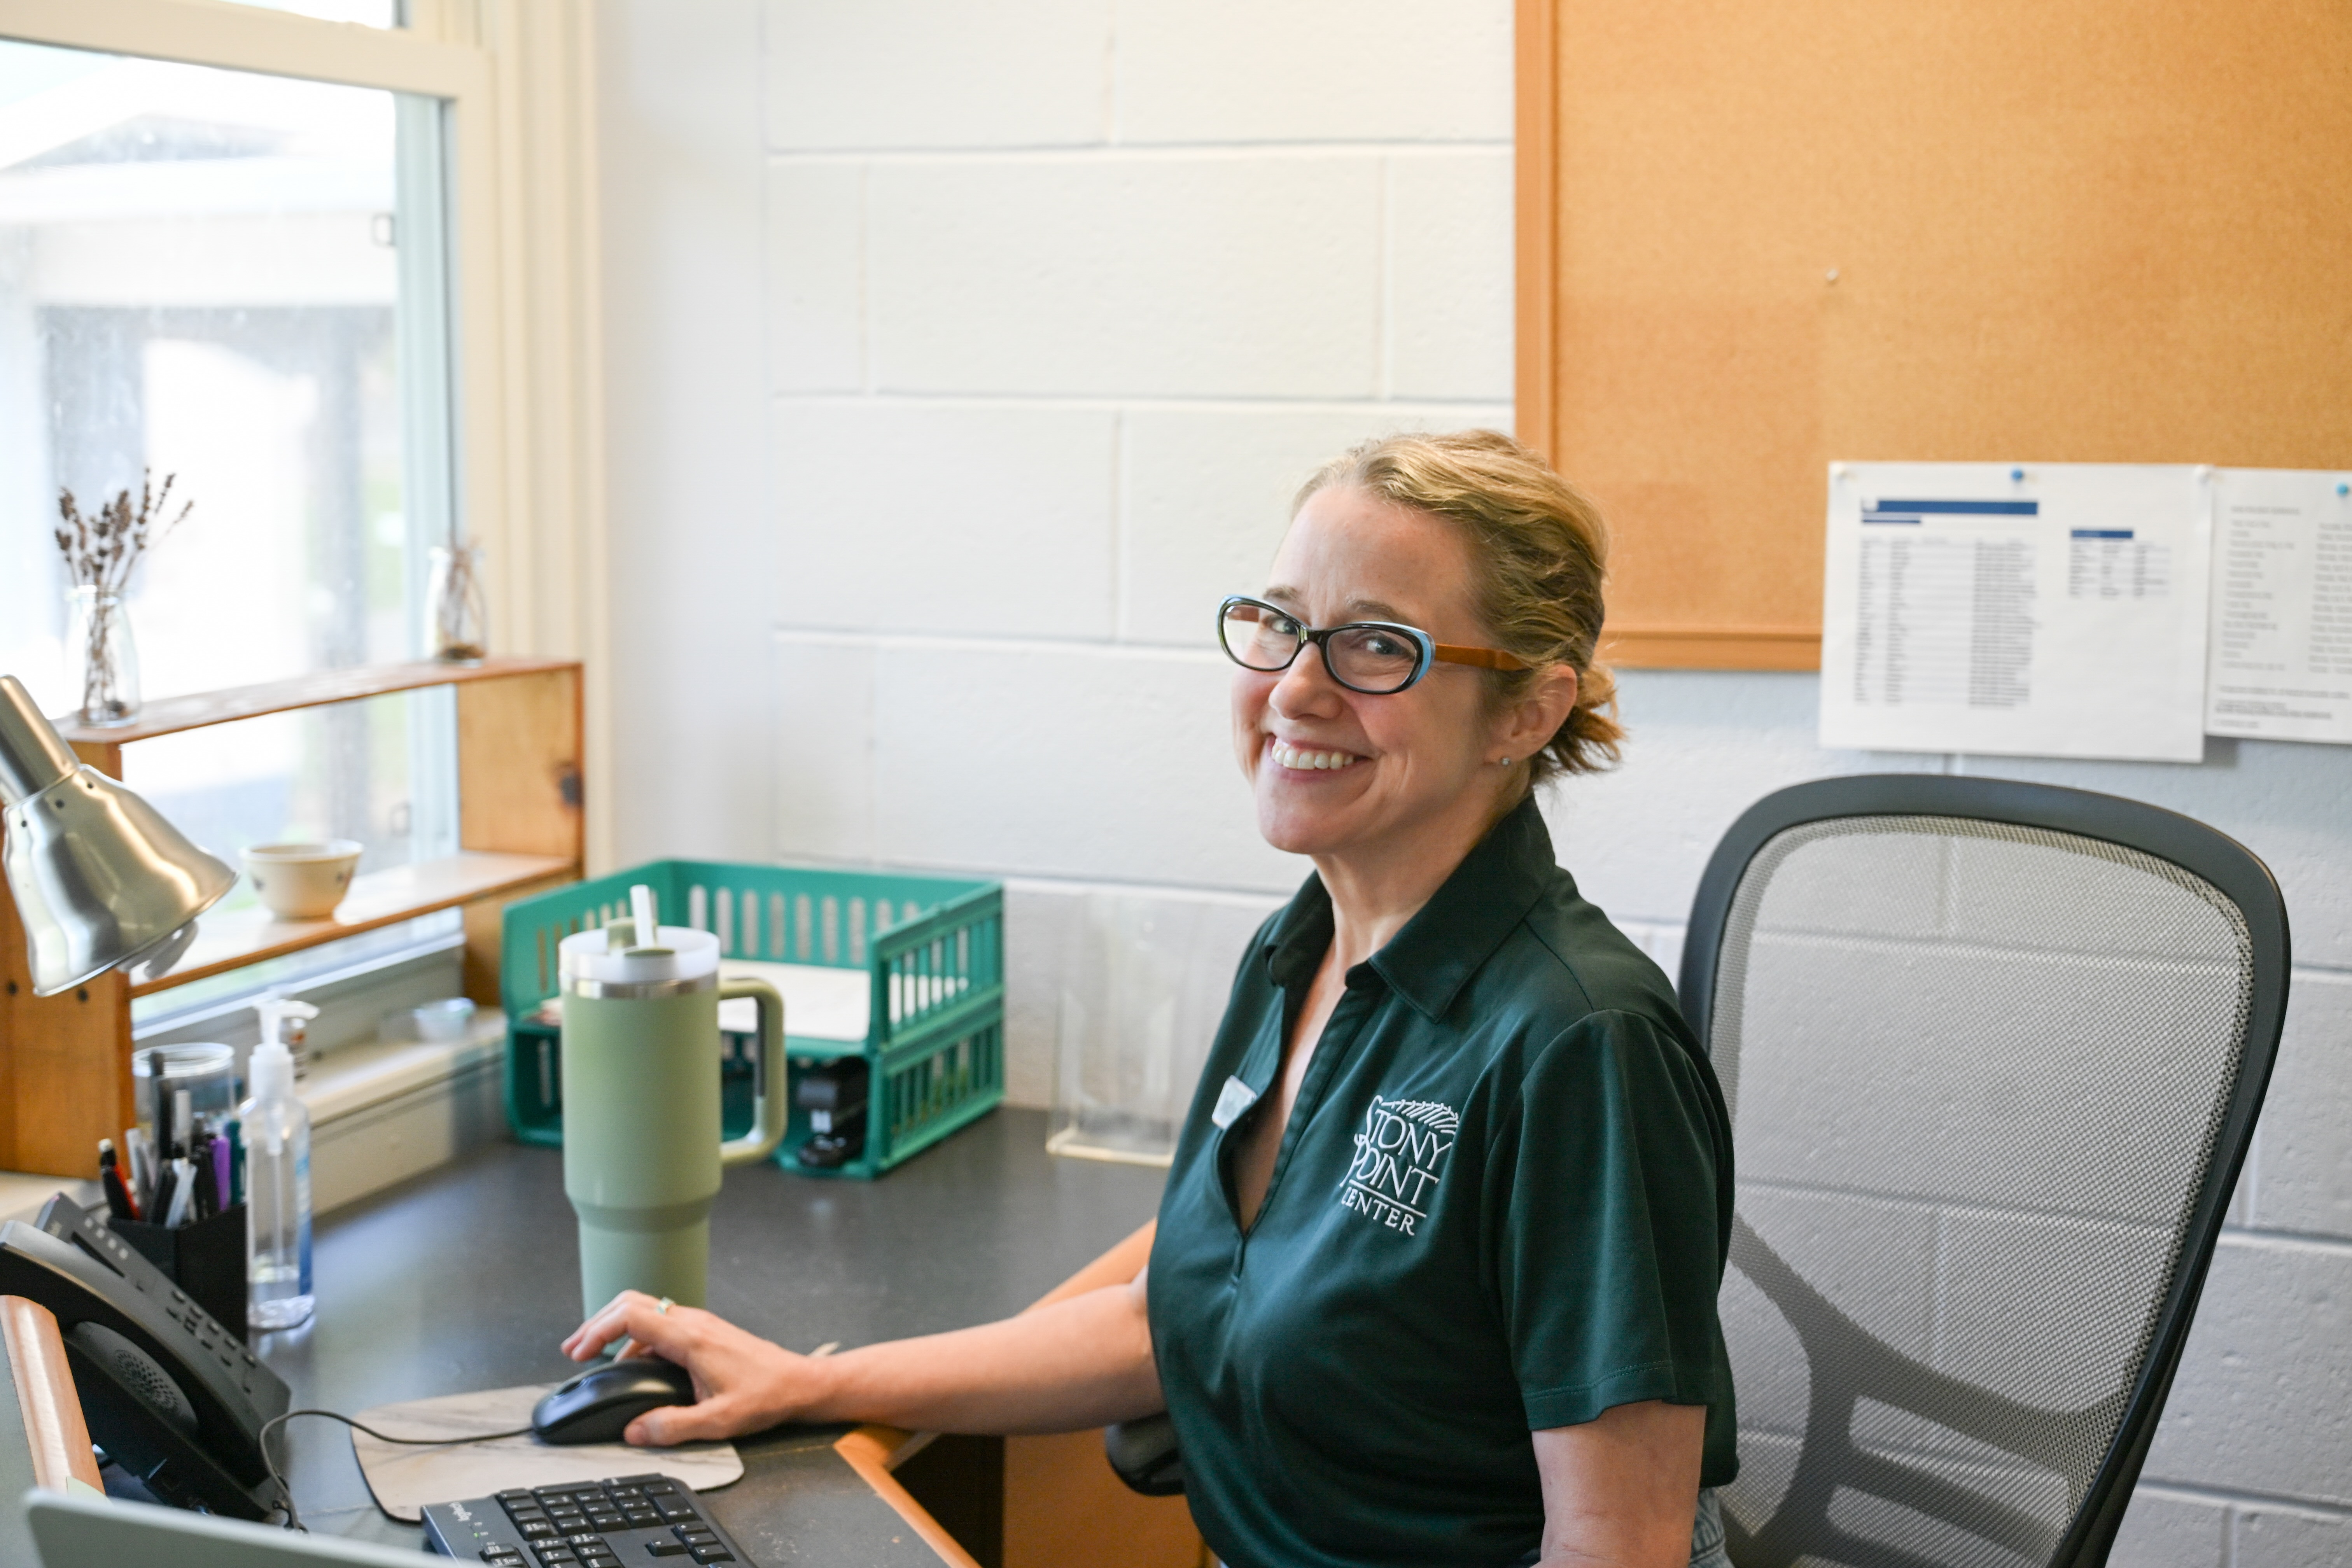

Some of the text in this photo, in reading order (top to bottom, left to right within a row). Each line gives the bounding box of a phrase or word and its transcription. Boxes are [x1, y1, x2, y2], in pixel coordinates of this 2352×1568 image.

[1366, 1095, 1453, 1170] STONY
[1339, 1133, 1440, 1205] POINT
[1341, 1186, 1415, 1236] CENTER
